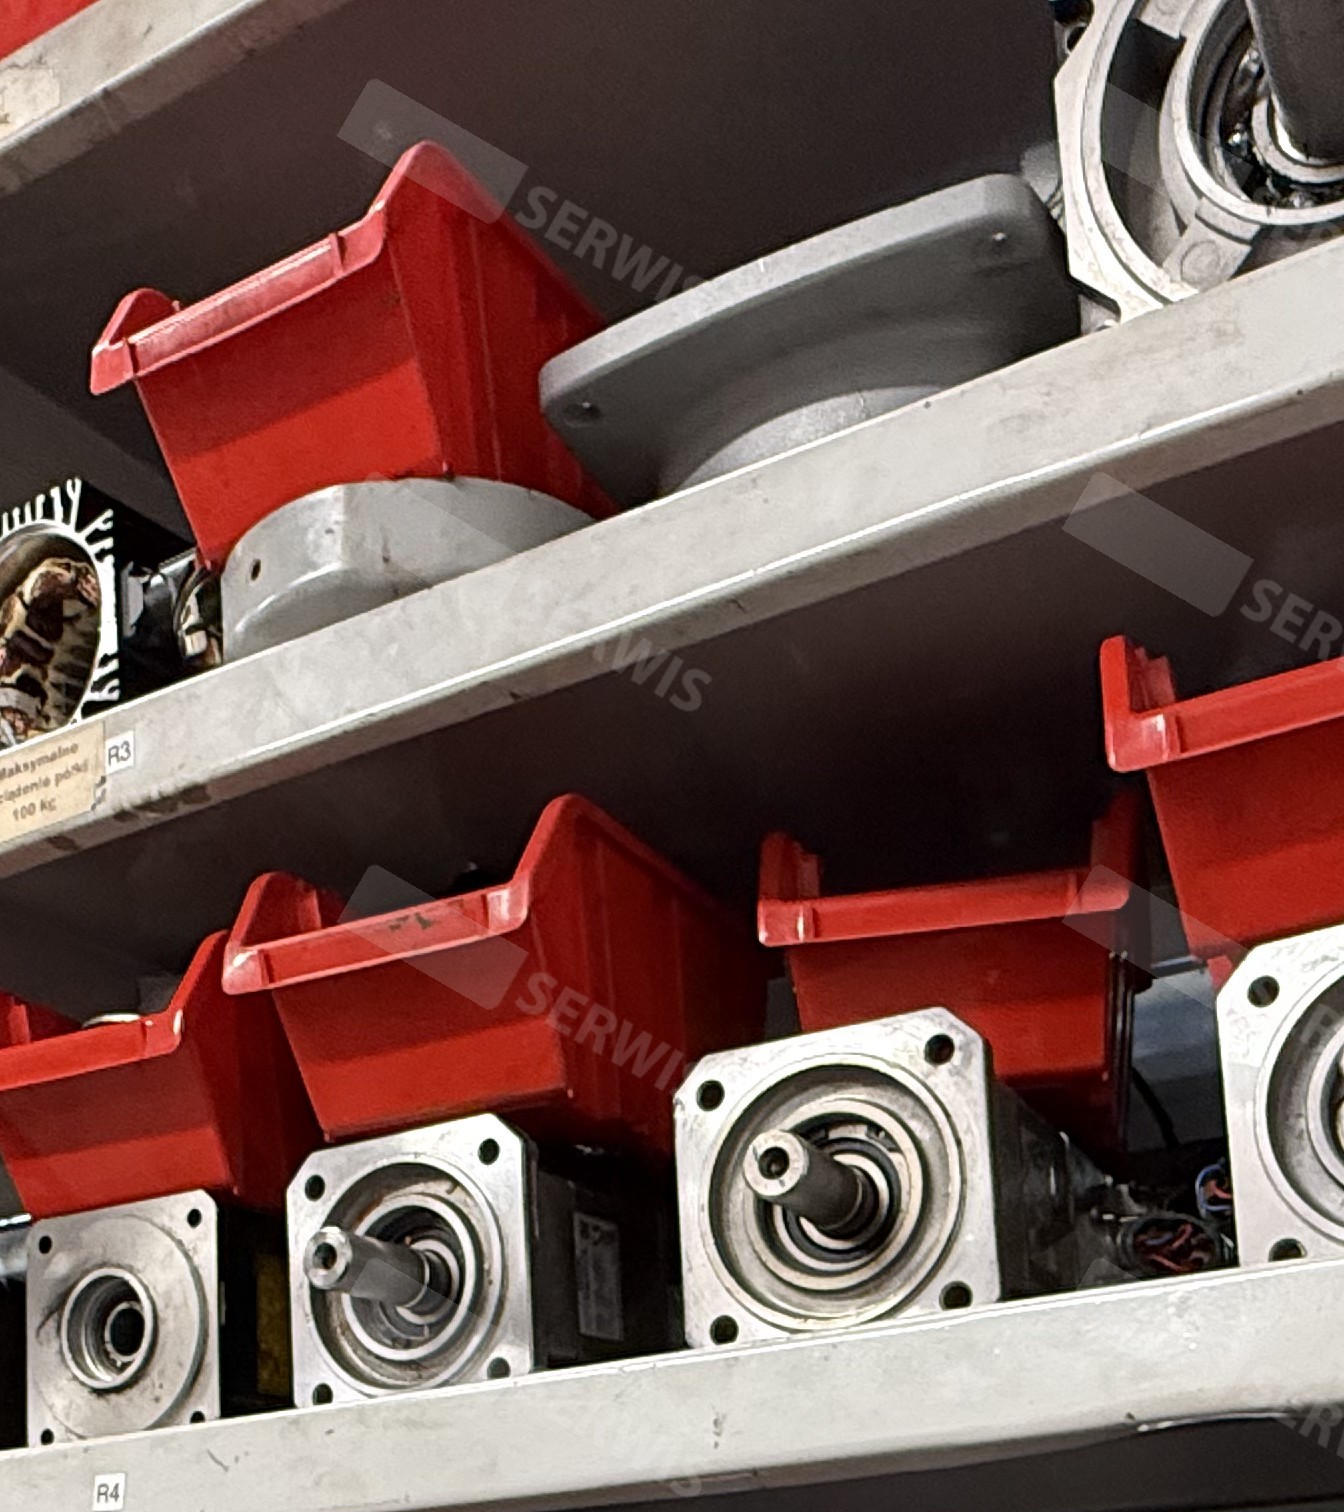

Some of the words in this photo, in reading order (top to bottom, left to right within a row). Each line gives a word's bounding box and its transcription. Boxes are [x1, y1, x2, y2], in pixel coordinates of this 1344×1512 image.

[107, 740, 132, 767] R3
[11, 801, 37, 822] 100
[96, 1482, 121, 1504] R4
